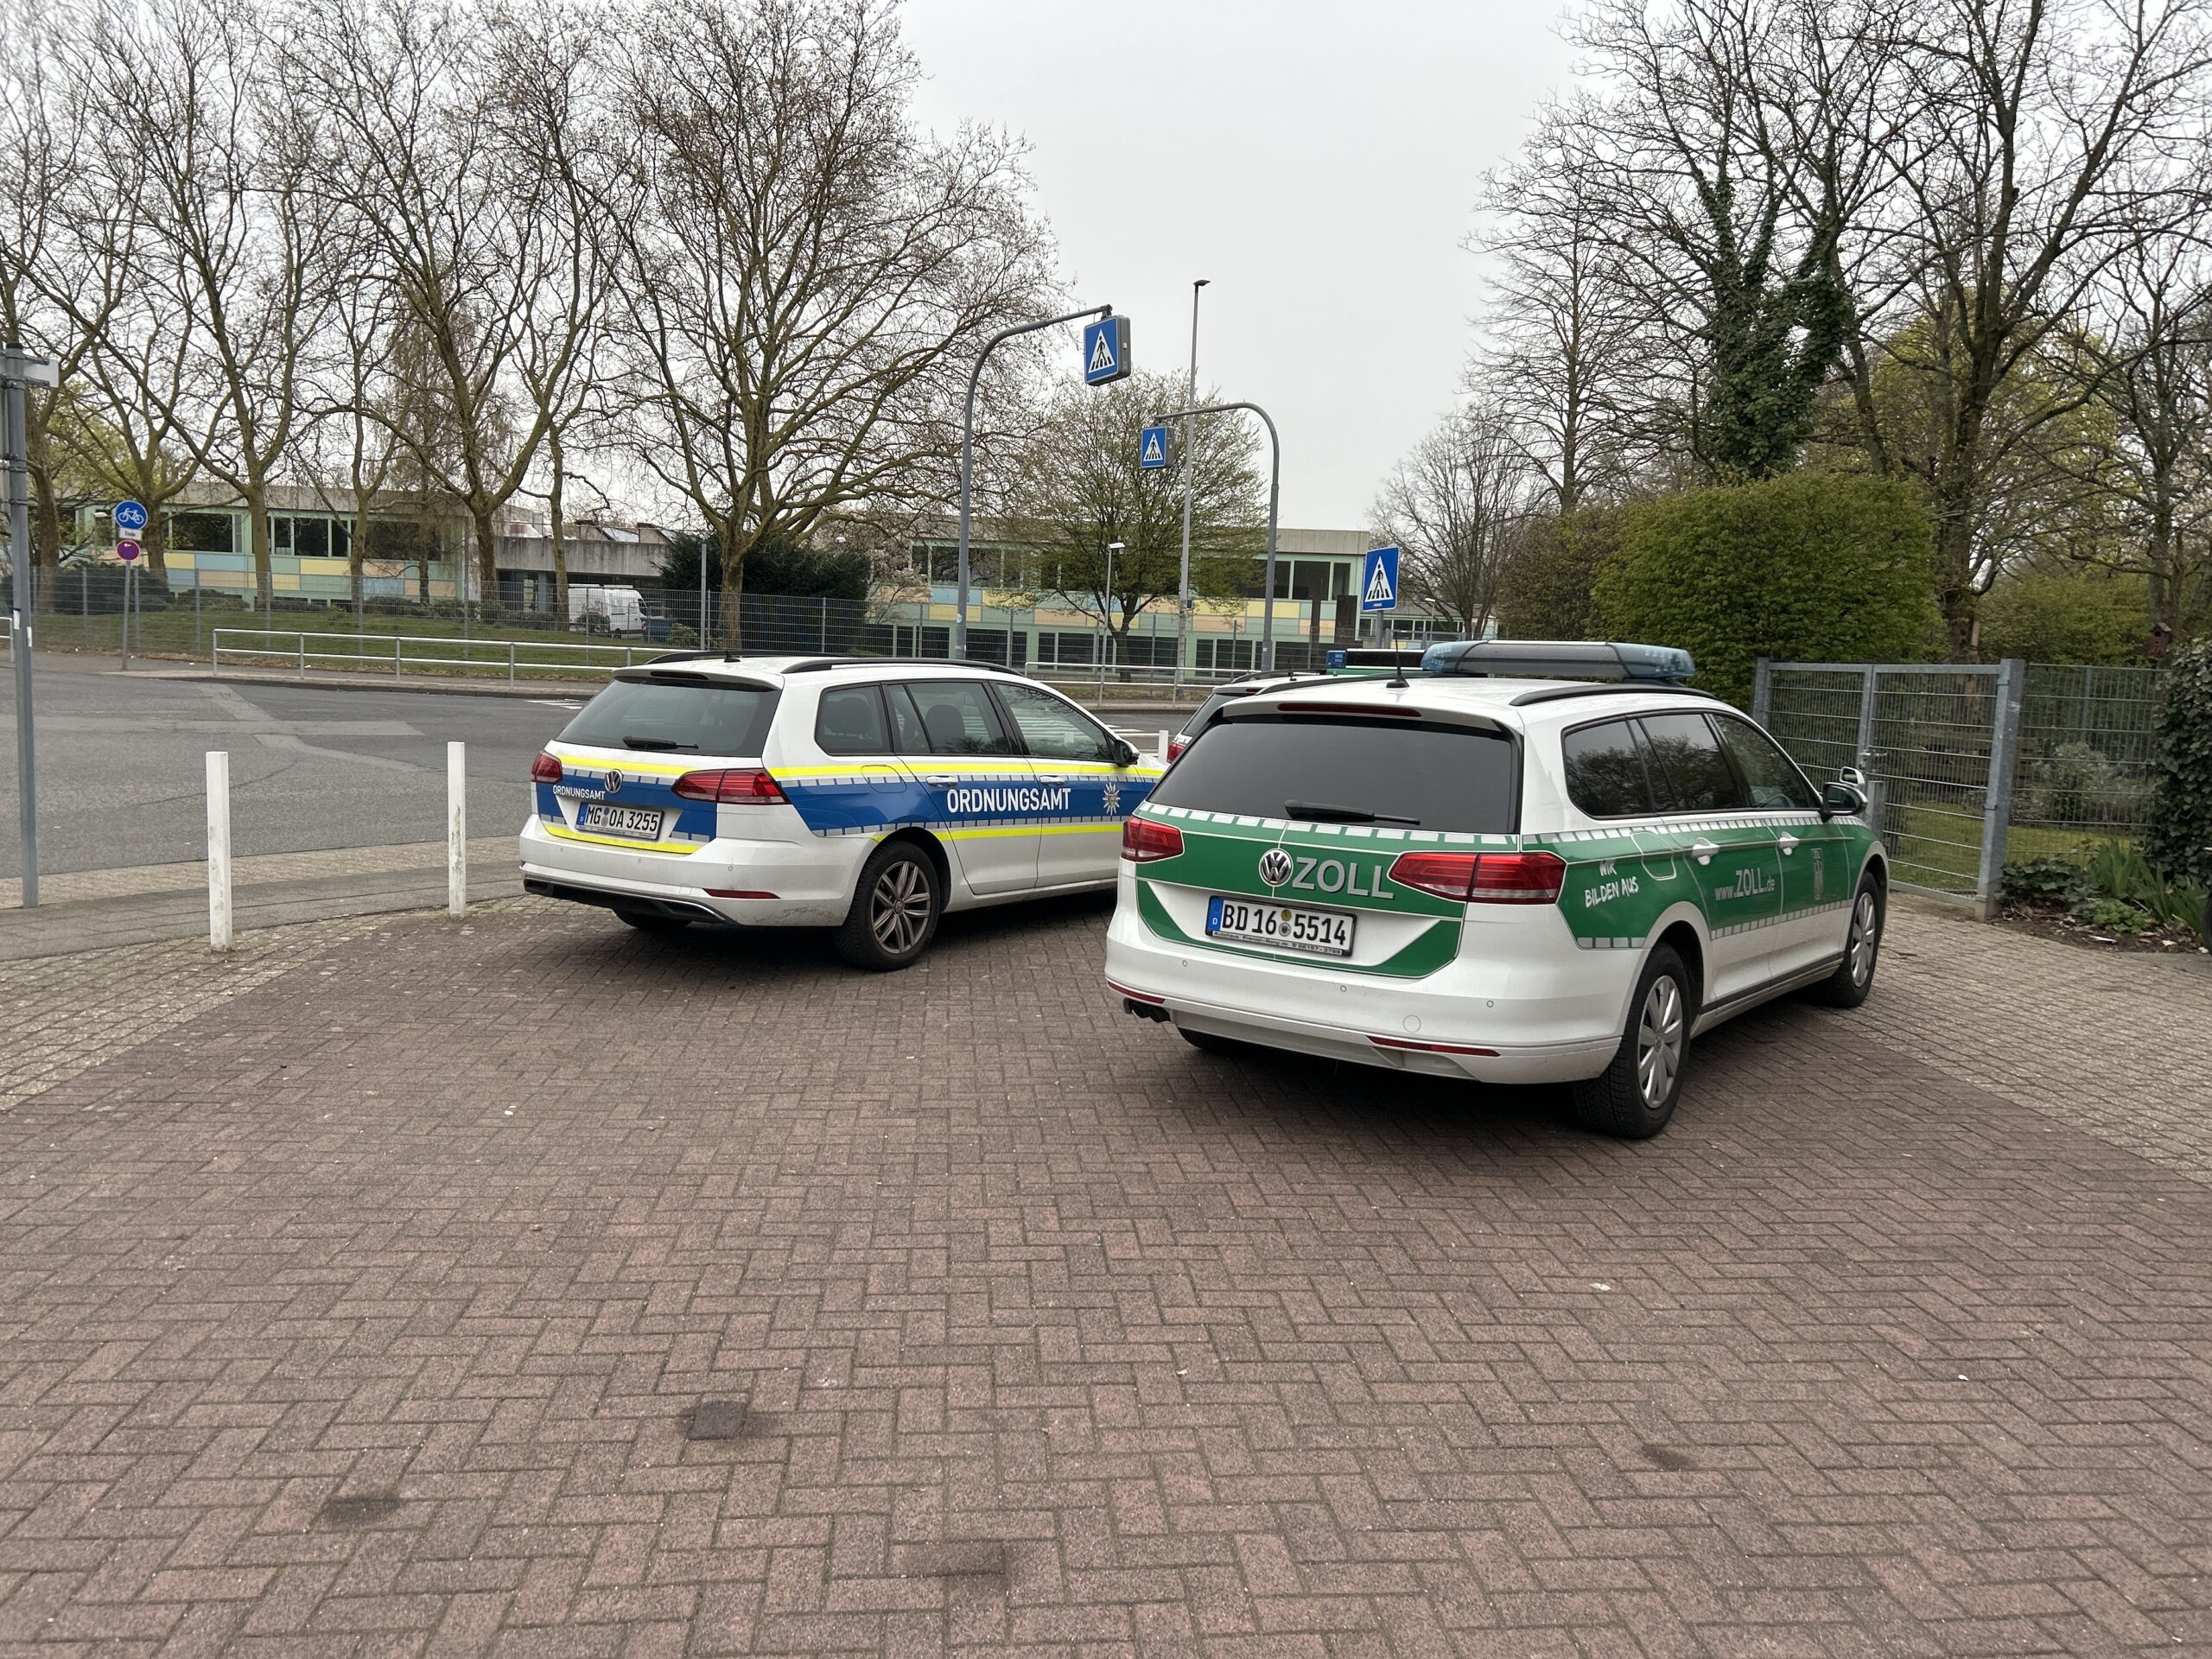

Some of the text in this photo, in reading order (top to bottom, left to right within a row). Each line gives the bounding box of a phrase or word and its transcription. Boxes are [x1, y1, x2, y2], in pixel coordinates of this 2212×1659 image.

[553, 785, 605, 800] ORDNUNGSAMT
[947, 788, 1071, 812] ORDNUNGSAMT
[586, 806, 601, 824] MG
[609, 809, 622, 828] OA
[626, 811, 658, 831] 3255
[1293, 857, 1394, 899] ZOLL
[1599, 858, 1618, 876] WIR
[1585, 876, 1639, 908] BILDEN AUS
[1714, 868, 1776, 901] www.ZOLL.de
[1223, 905, 1249, 931] BD
[1252, 909, 1277, 936] 16
[1294, 914, 1345, 945] 5514
